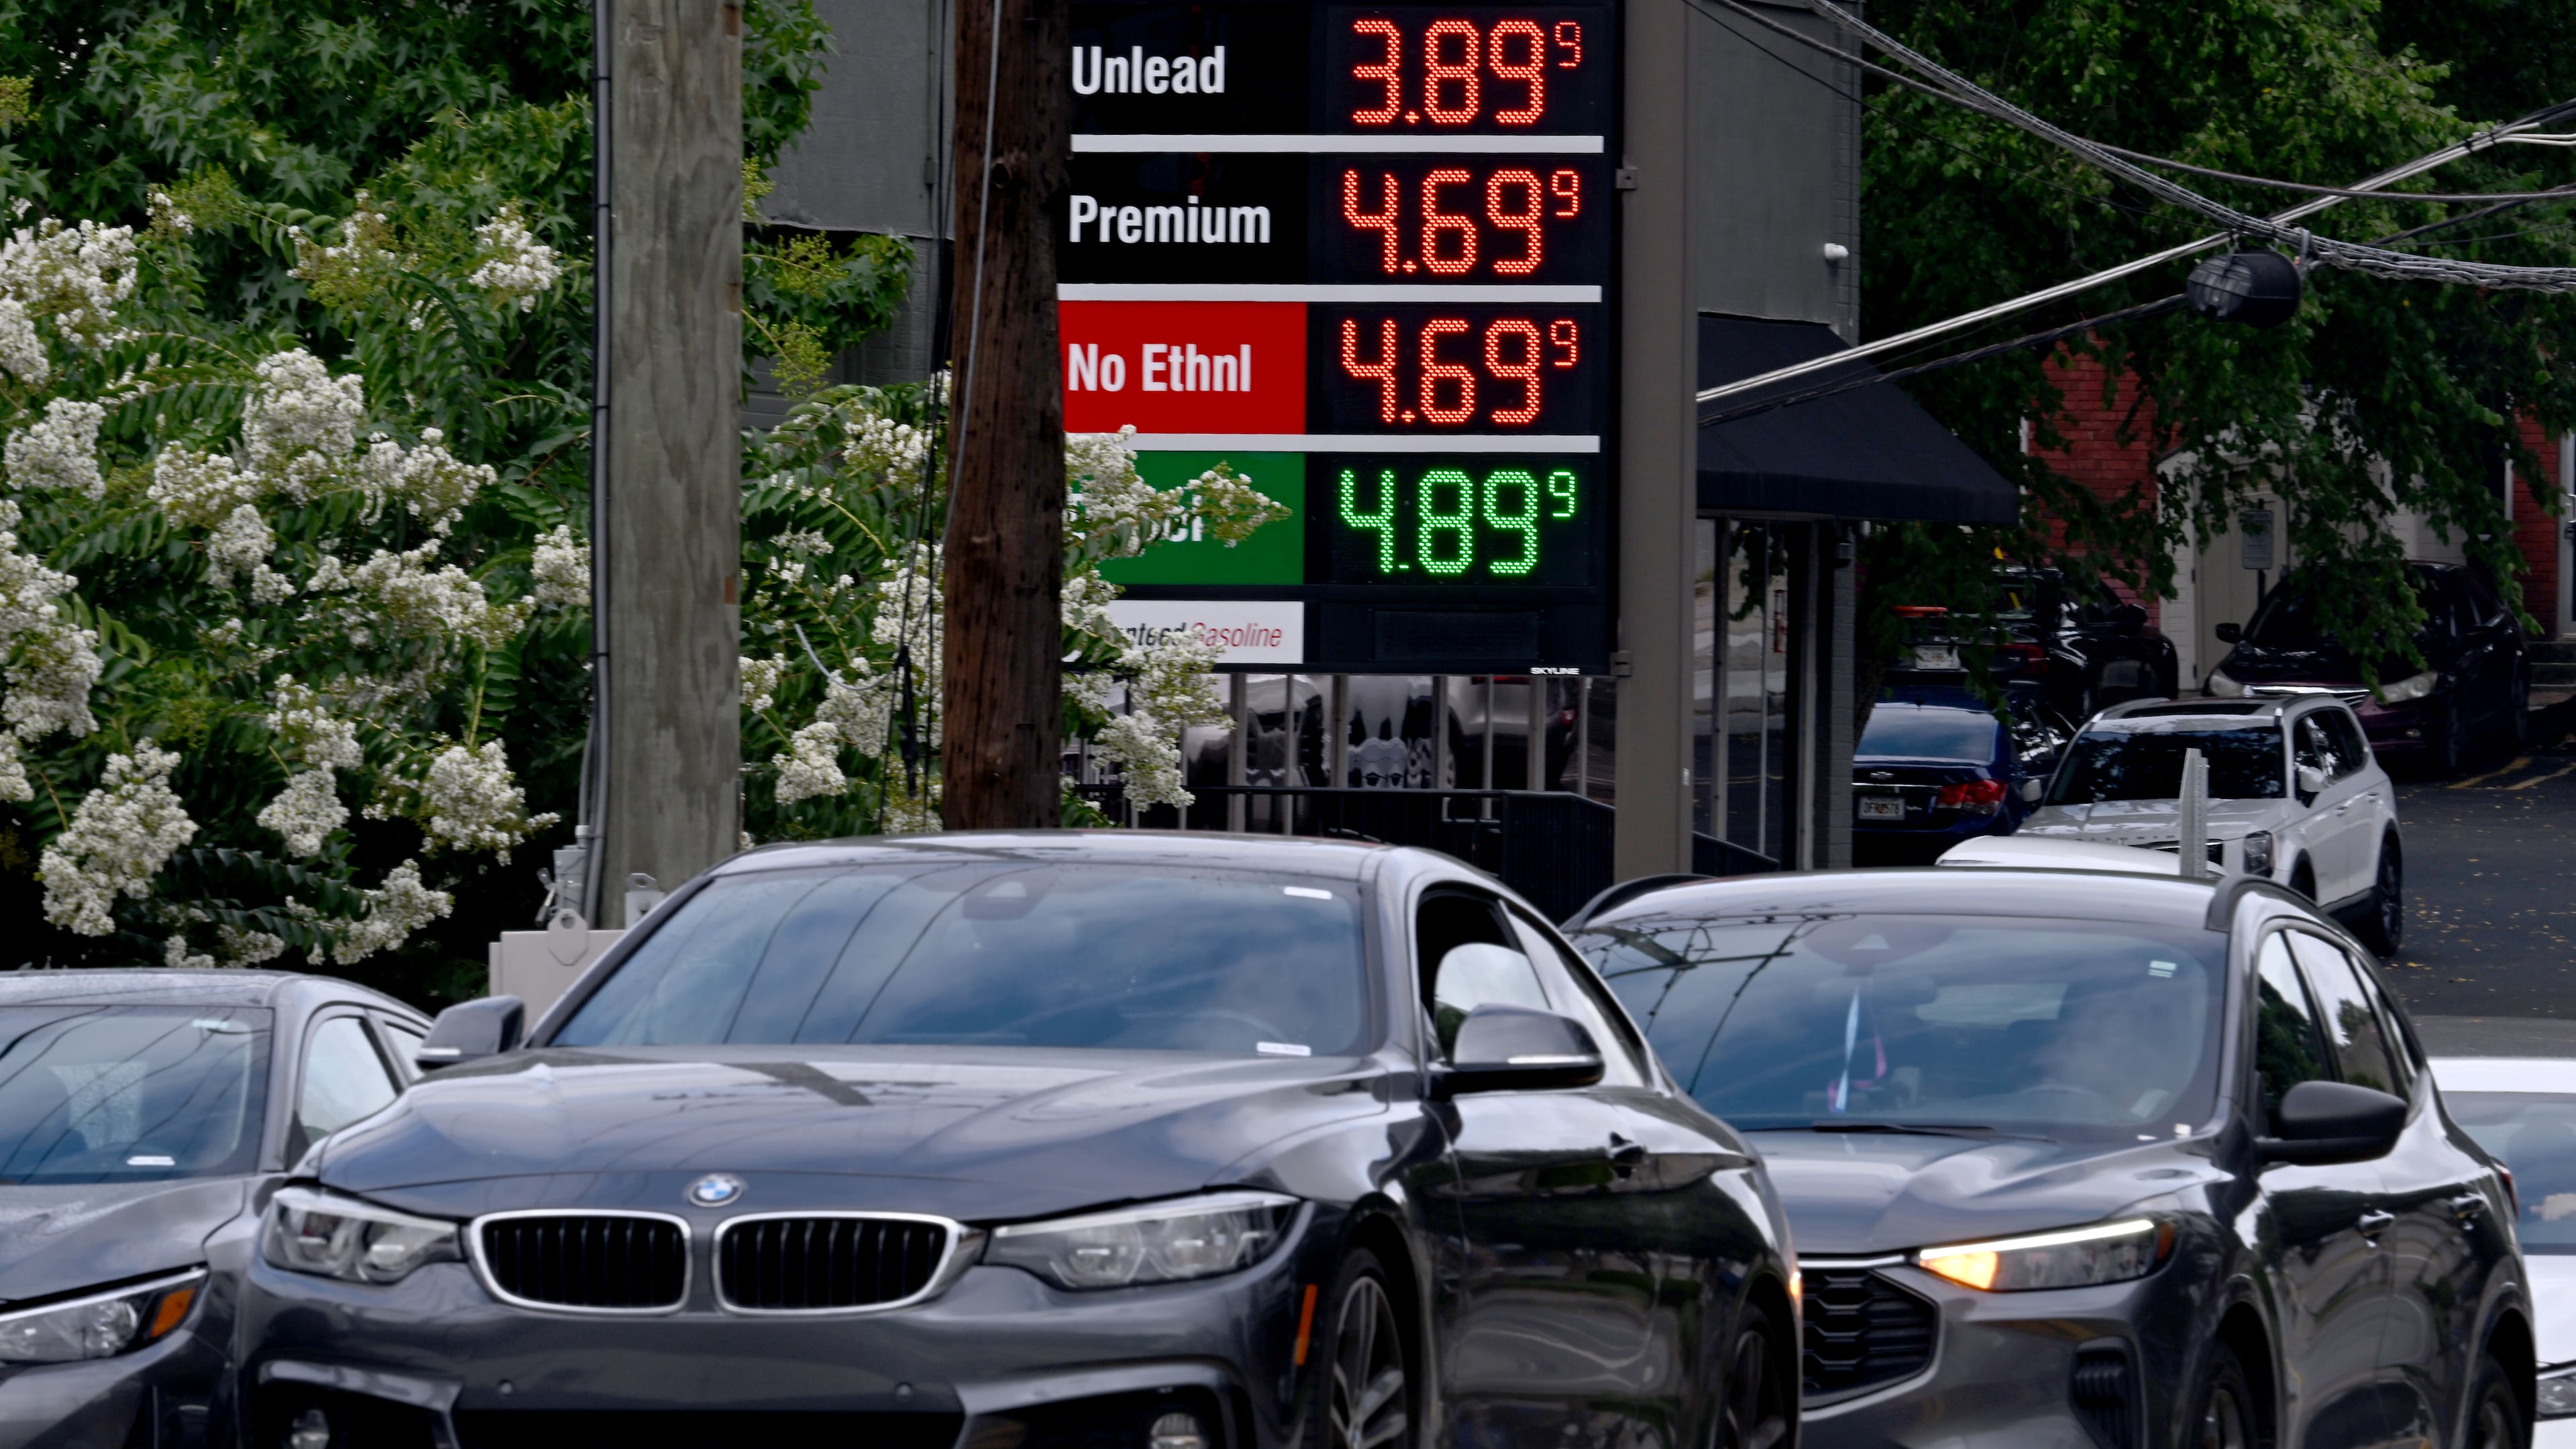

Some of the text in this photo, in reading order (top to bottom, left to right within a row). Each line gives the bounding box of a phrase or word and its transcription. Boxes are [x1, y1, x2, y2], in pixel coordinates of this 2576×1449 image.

[1073, 46, 1225, 95] Unlead
[1069, 195, 1271, 244] Premium
[1068, 343, 1251, 392] No Ethnl
[1530, 667, 1580, 675] SKYLINE
